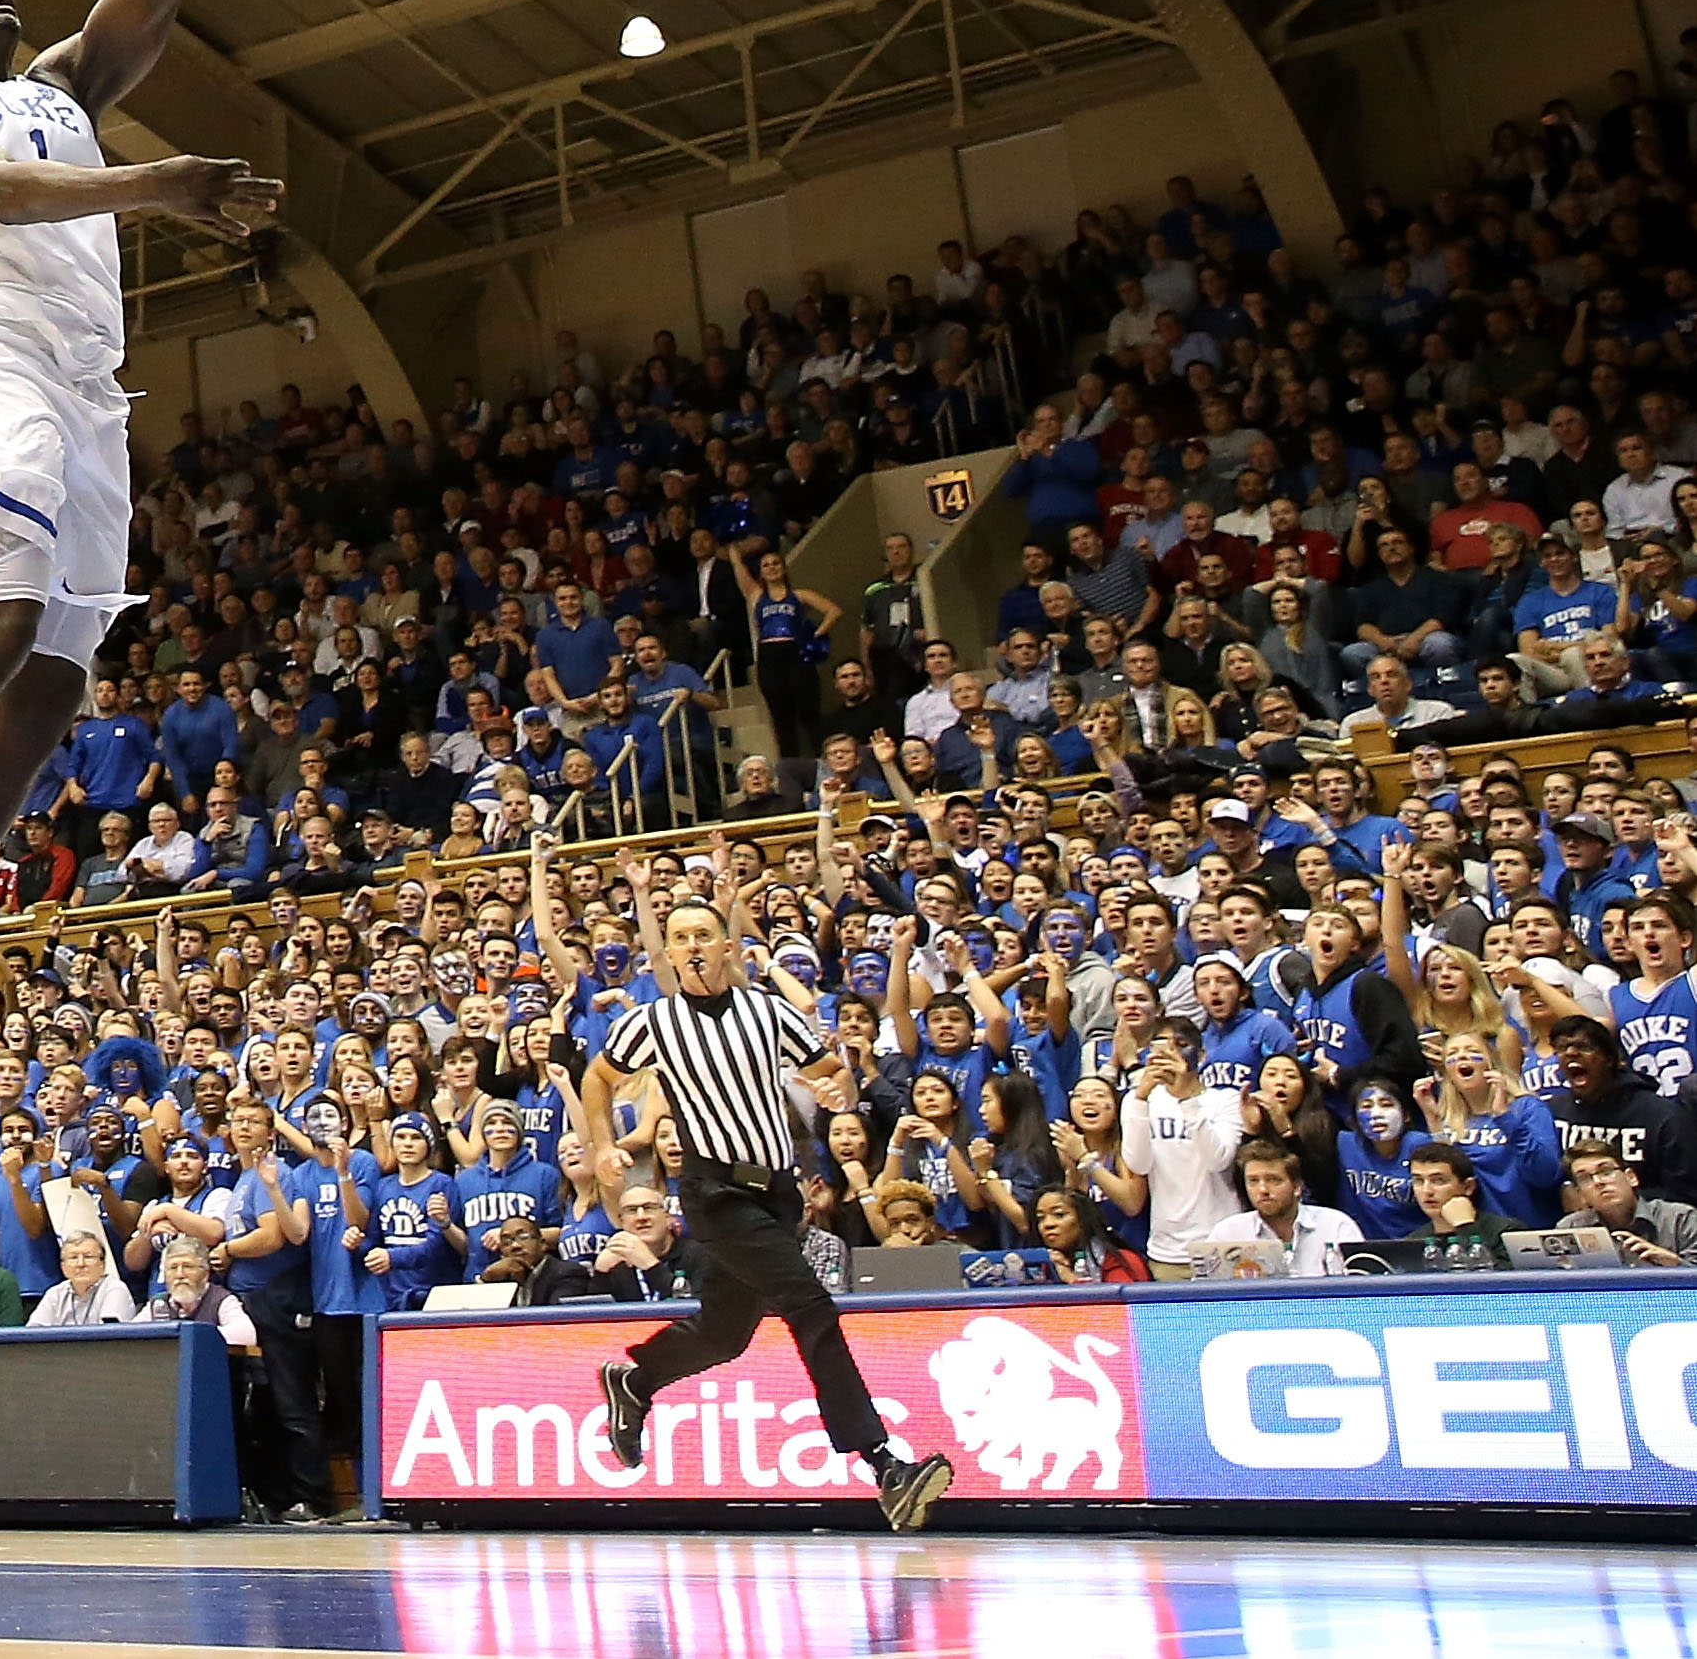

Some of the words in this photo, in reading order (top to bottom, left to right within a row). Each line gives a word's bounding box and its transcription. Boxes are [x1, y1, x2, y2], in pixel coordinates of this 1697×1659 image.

[29, 128, 48, 160] 1
[931, 484, 967, 515] 14
[1620, 1015, 1690, 1056] DUKE
[464, 1190, 537, 1228] DUKE
